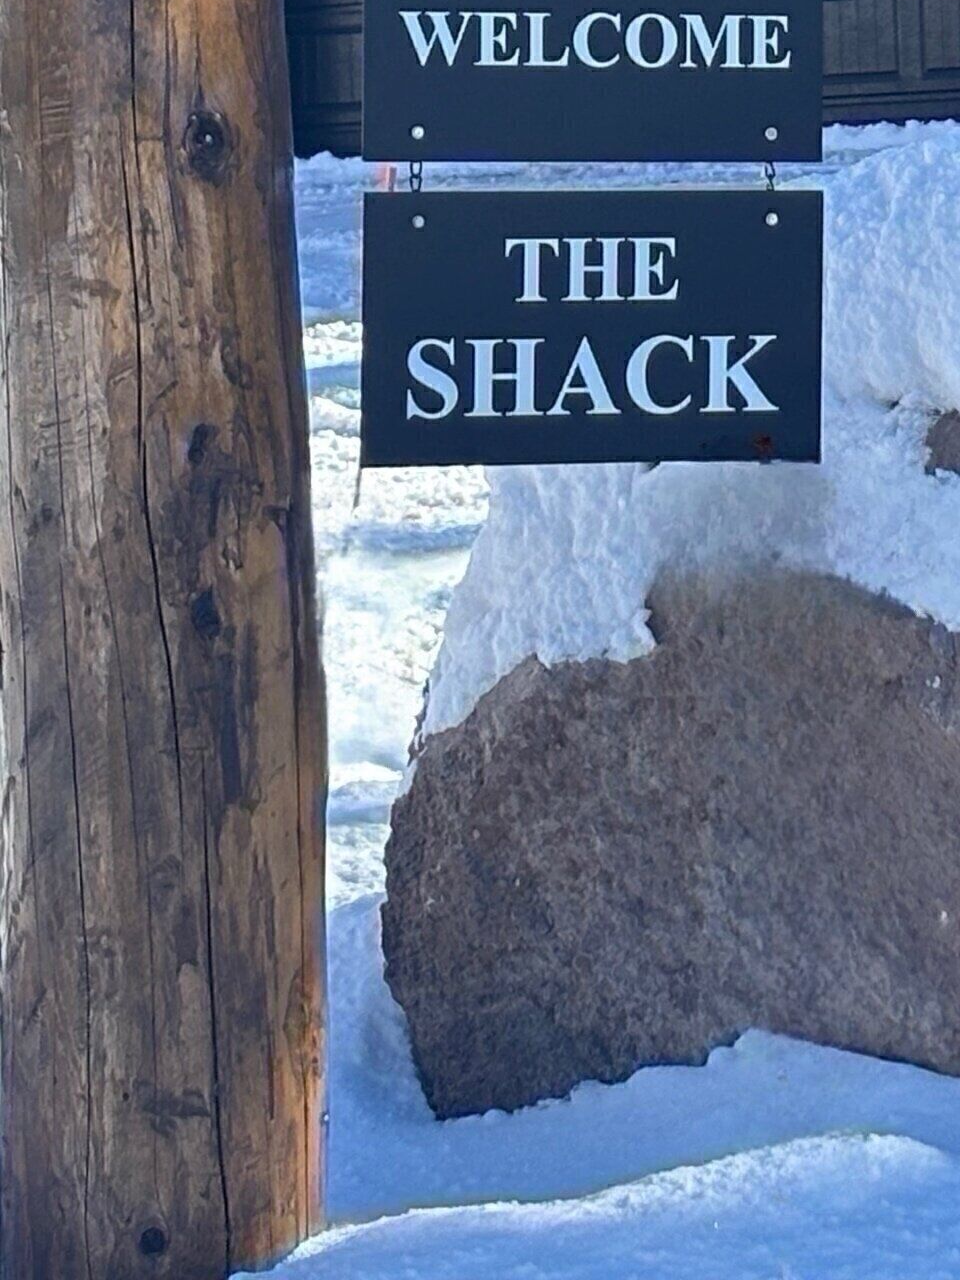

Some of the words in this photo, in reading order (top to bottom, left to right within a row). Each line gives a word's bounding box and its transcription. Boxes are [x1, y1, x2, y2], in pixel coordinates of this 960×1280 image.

[398, 11, 791, 69] WELCOME
[504, 237, 679, 302] THE
[406, 334, 780, 420] SHACK
